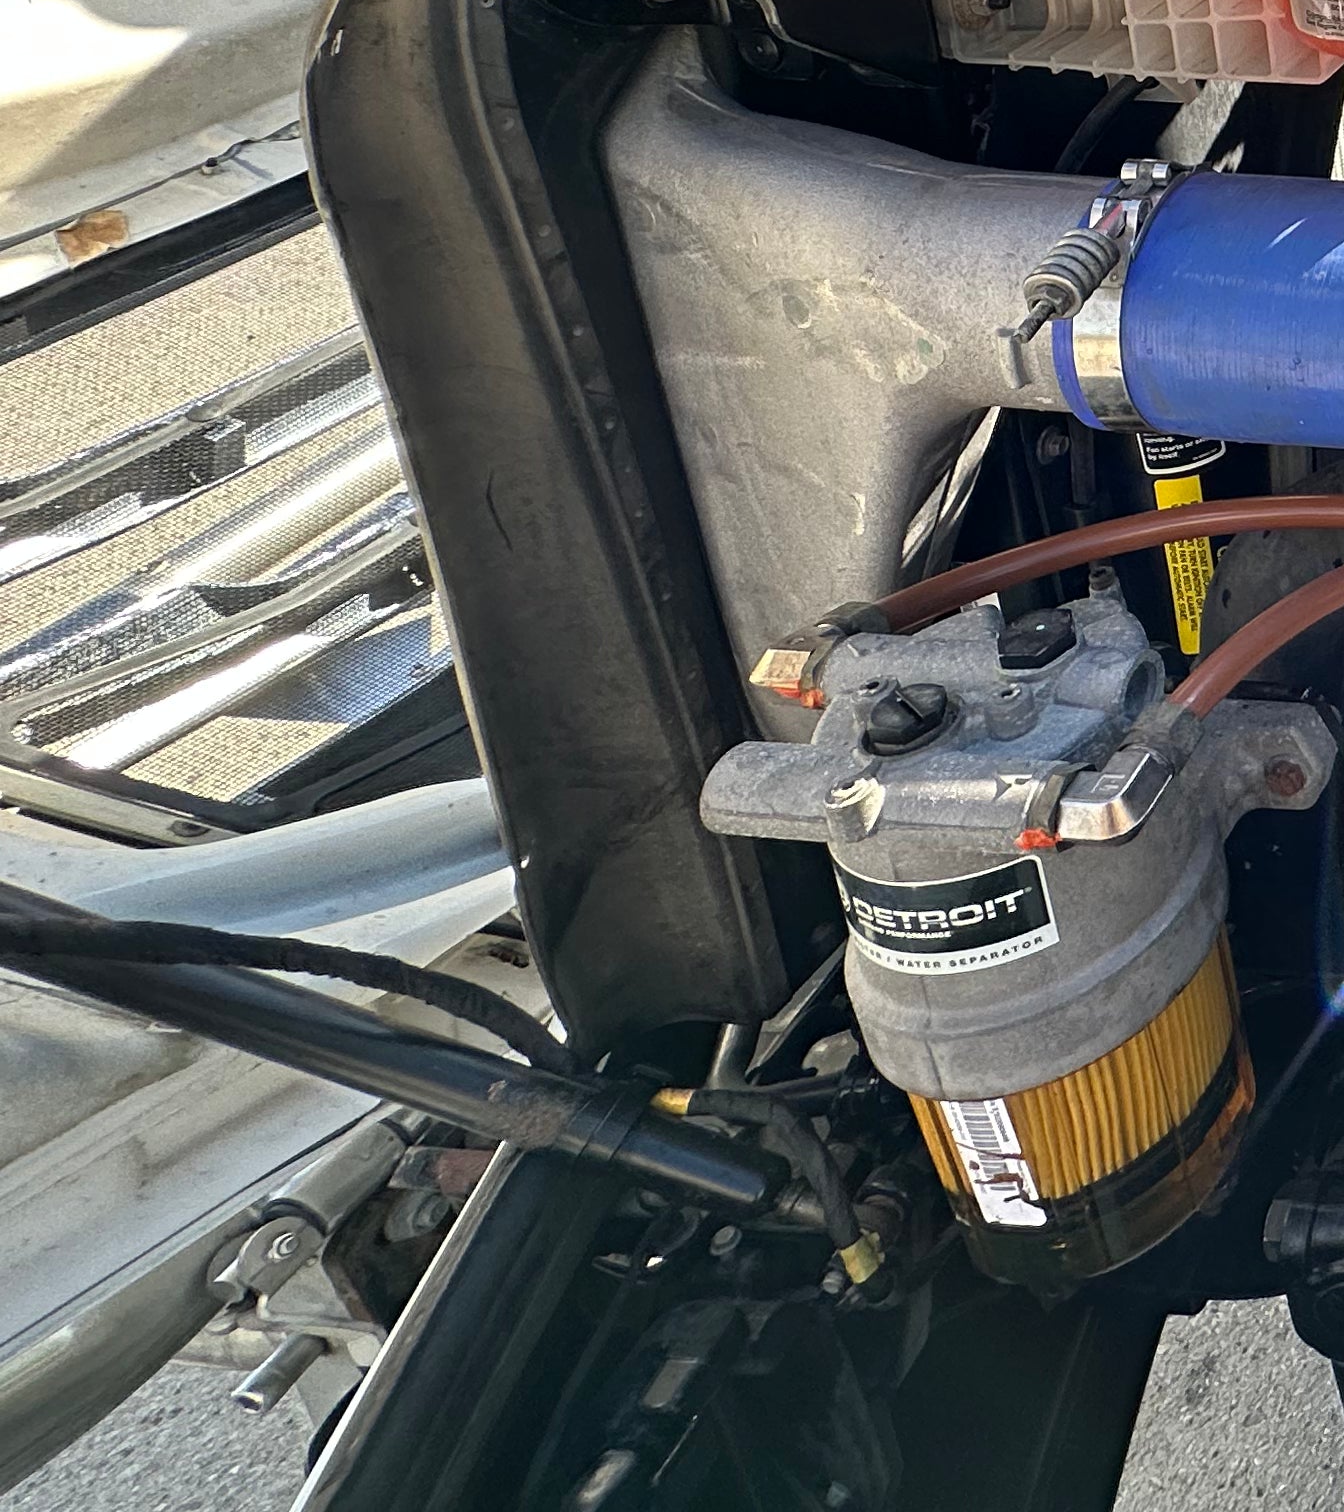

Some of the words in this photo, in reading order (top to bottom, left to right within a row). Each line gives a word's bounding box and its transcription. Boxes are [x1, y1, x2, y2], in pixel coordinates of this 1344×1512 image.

[852, 889, 1025, 930] DETROIT
[886, 928, 952, 940] PERFORMANCE
[896, 959, 942, 969] WATER
[950, 936, 1044, 968] SEPARATOR
